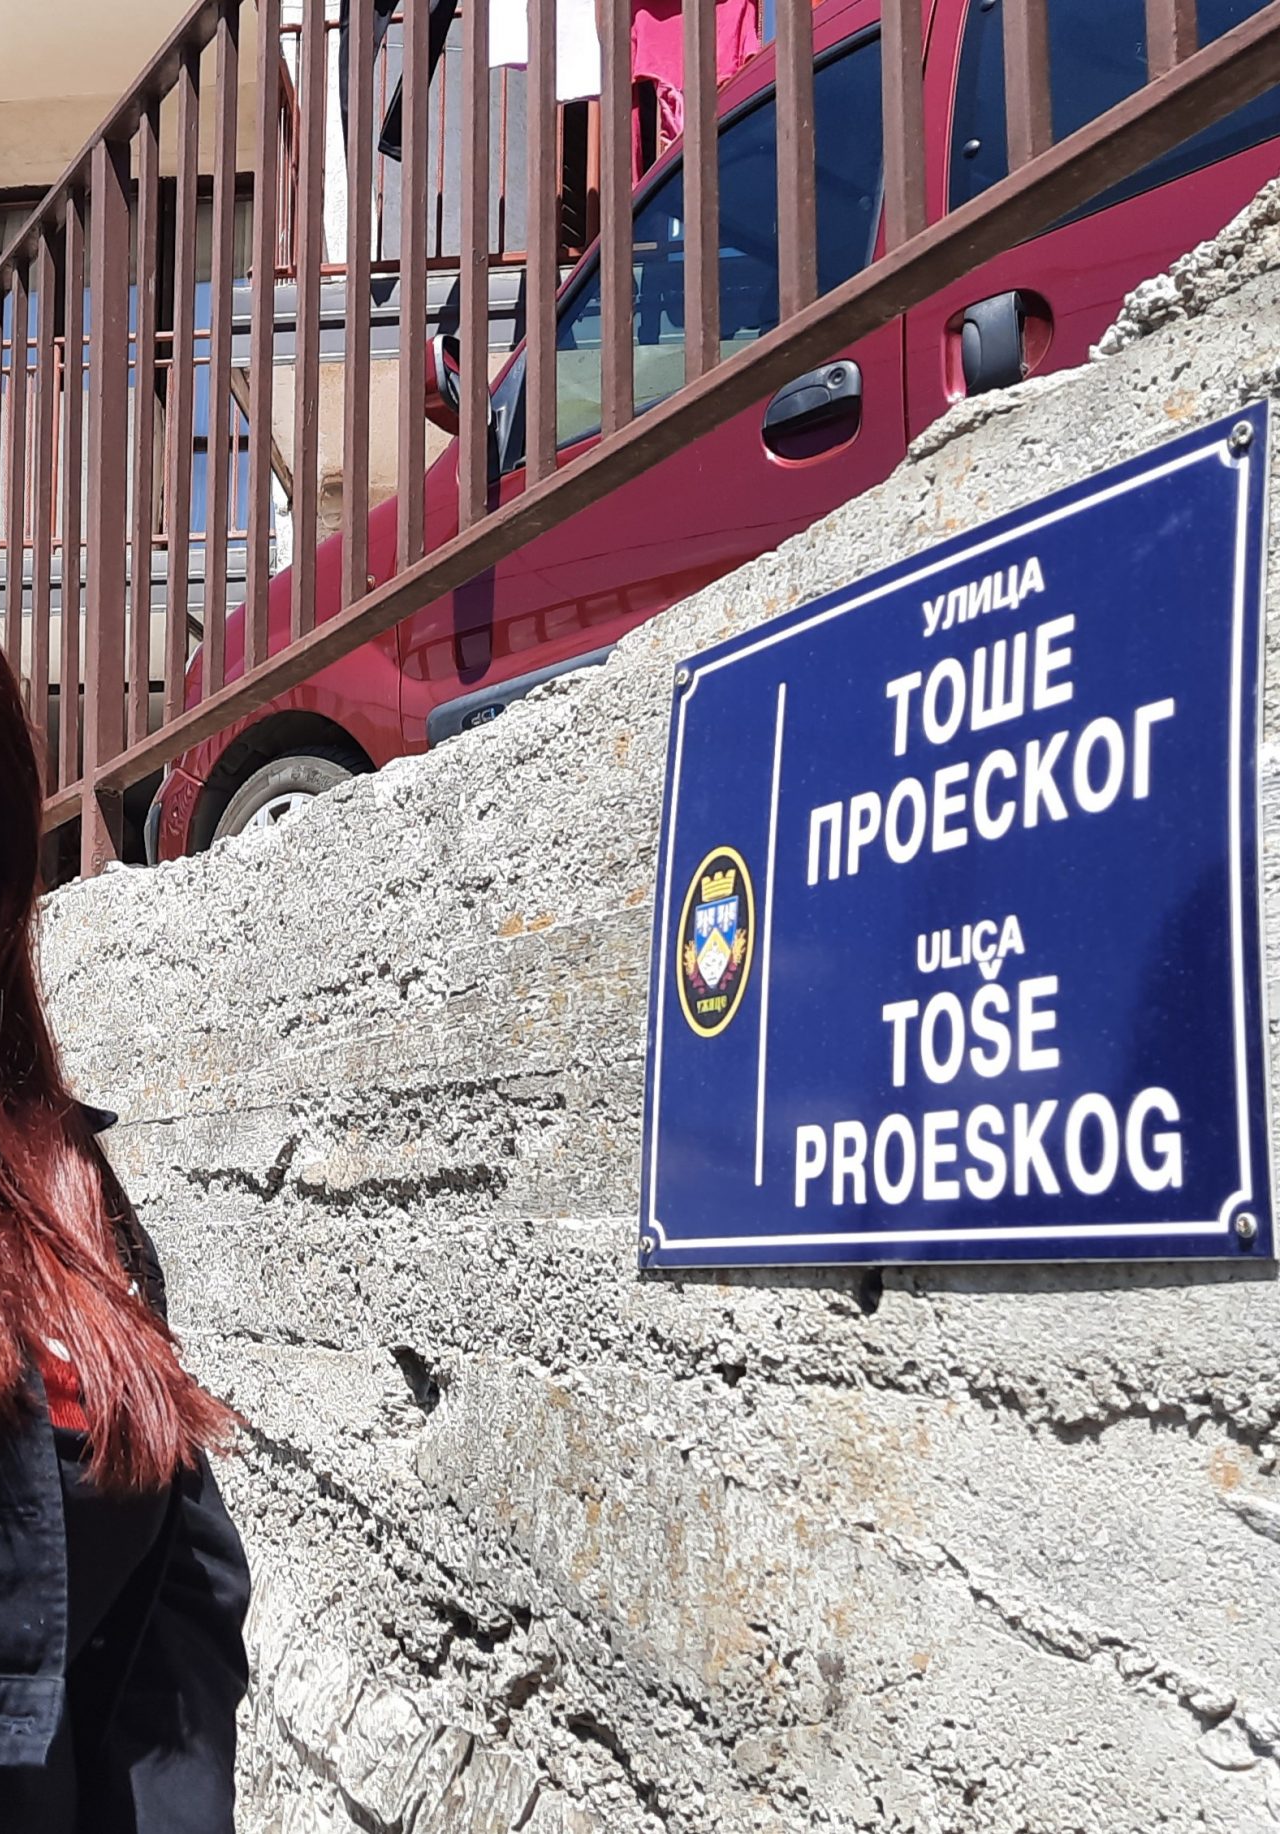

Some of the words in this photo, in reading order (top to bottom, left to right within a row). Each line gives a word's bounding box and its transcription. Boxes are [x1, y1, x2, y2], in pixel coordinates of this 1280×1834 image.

[922, 556, 1045, 637] УЛИЦА
[886, 614, 1075, 756] ТОШЕ
[807, 698, 1176, 886] ПРОЕСКОГ
[917, 914, 1025, 973] ULICA
[882, 959, 1060, 1087] TOŠE
[795, 1087, 1183, 1207] PROESKOG
